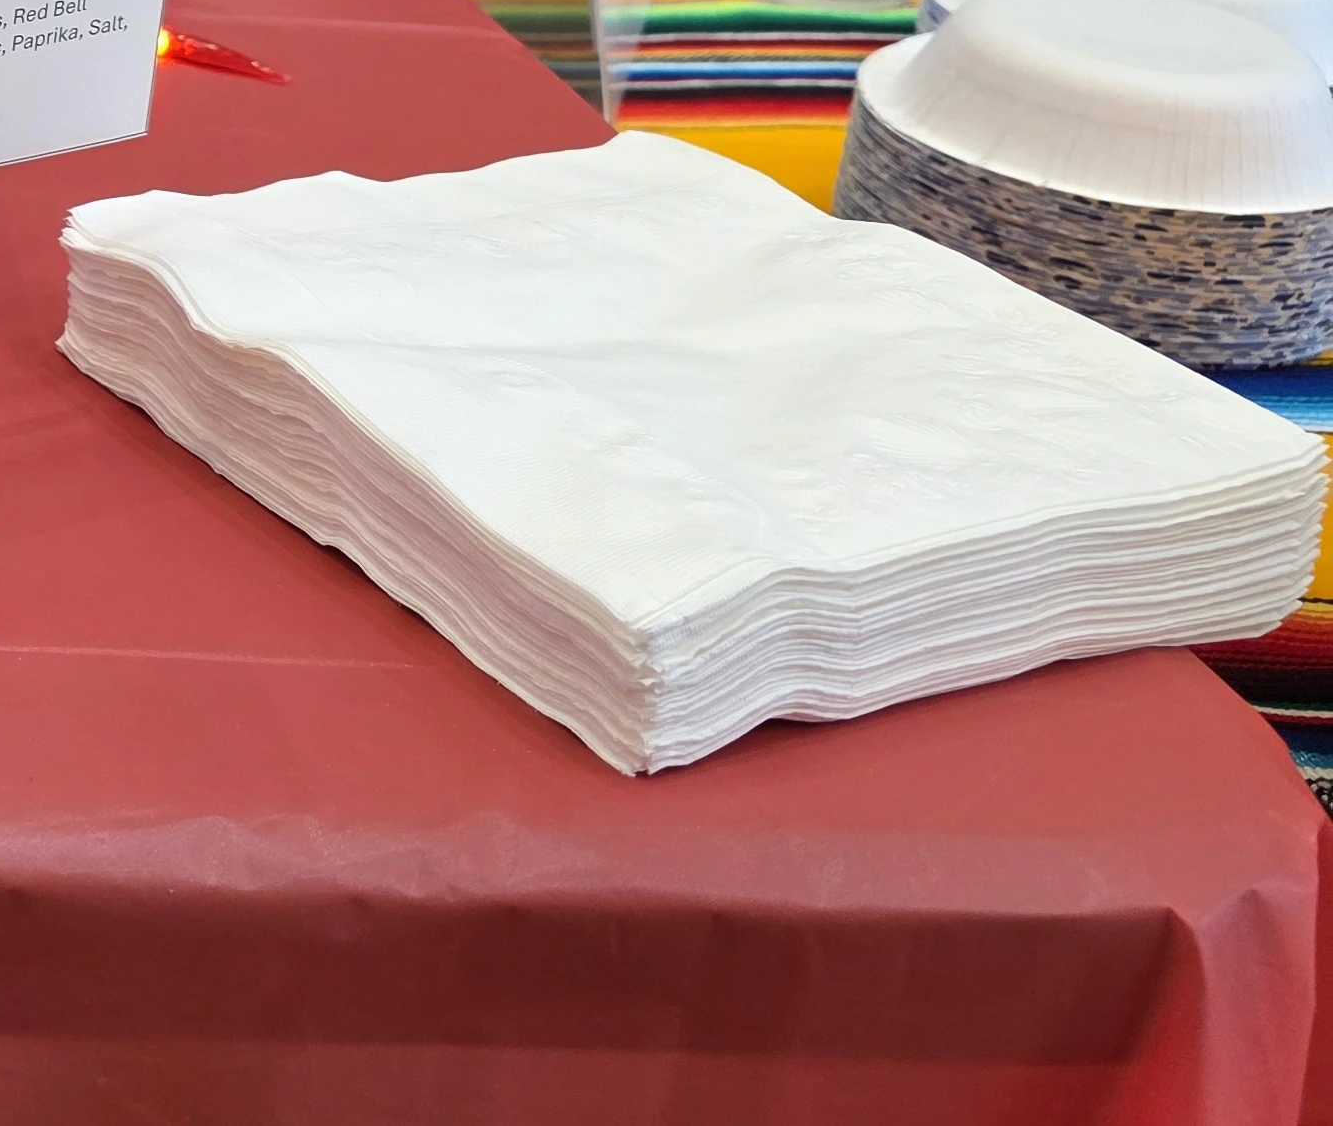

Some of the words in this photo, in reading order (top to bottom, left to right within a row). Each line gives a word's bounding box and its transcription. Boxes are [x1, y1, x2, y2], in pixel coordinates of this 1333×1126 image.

[13, 2, 49, 26] Red
[11, 25, 84, 53] Paprika,
[88, 14, 129, 37] Salt,
